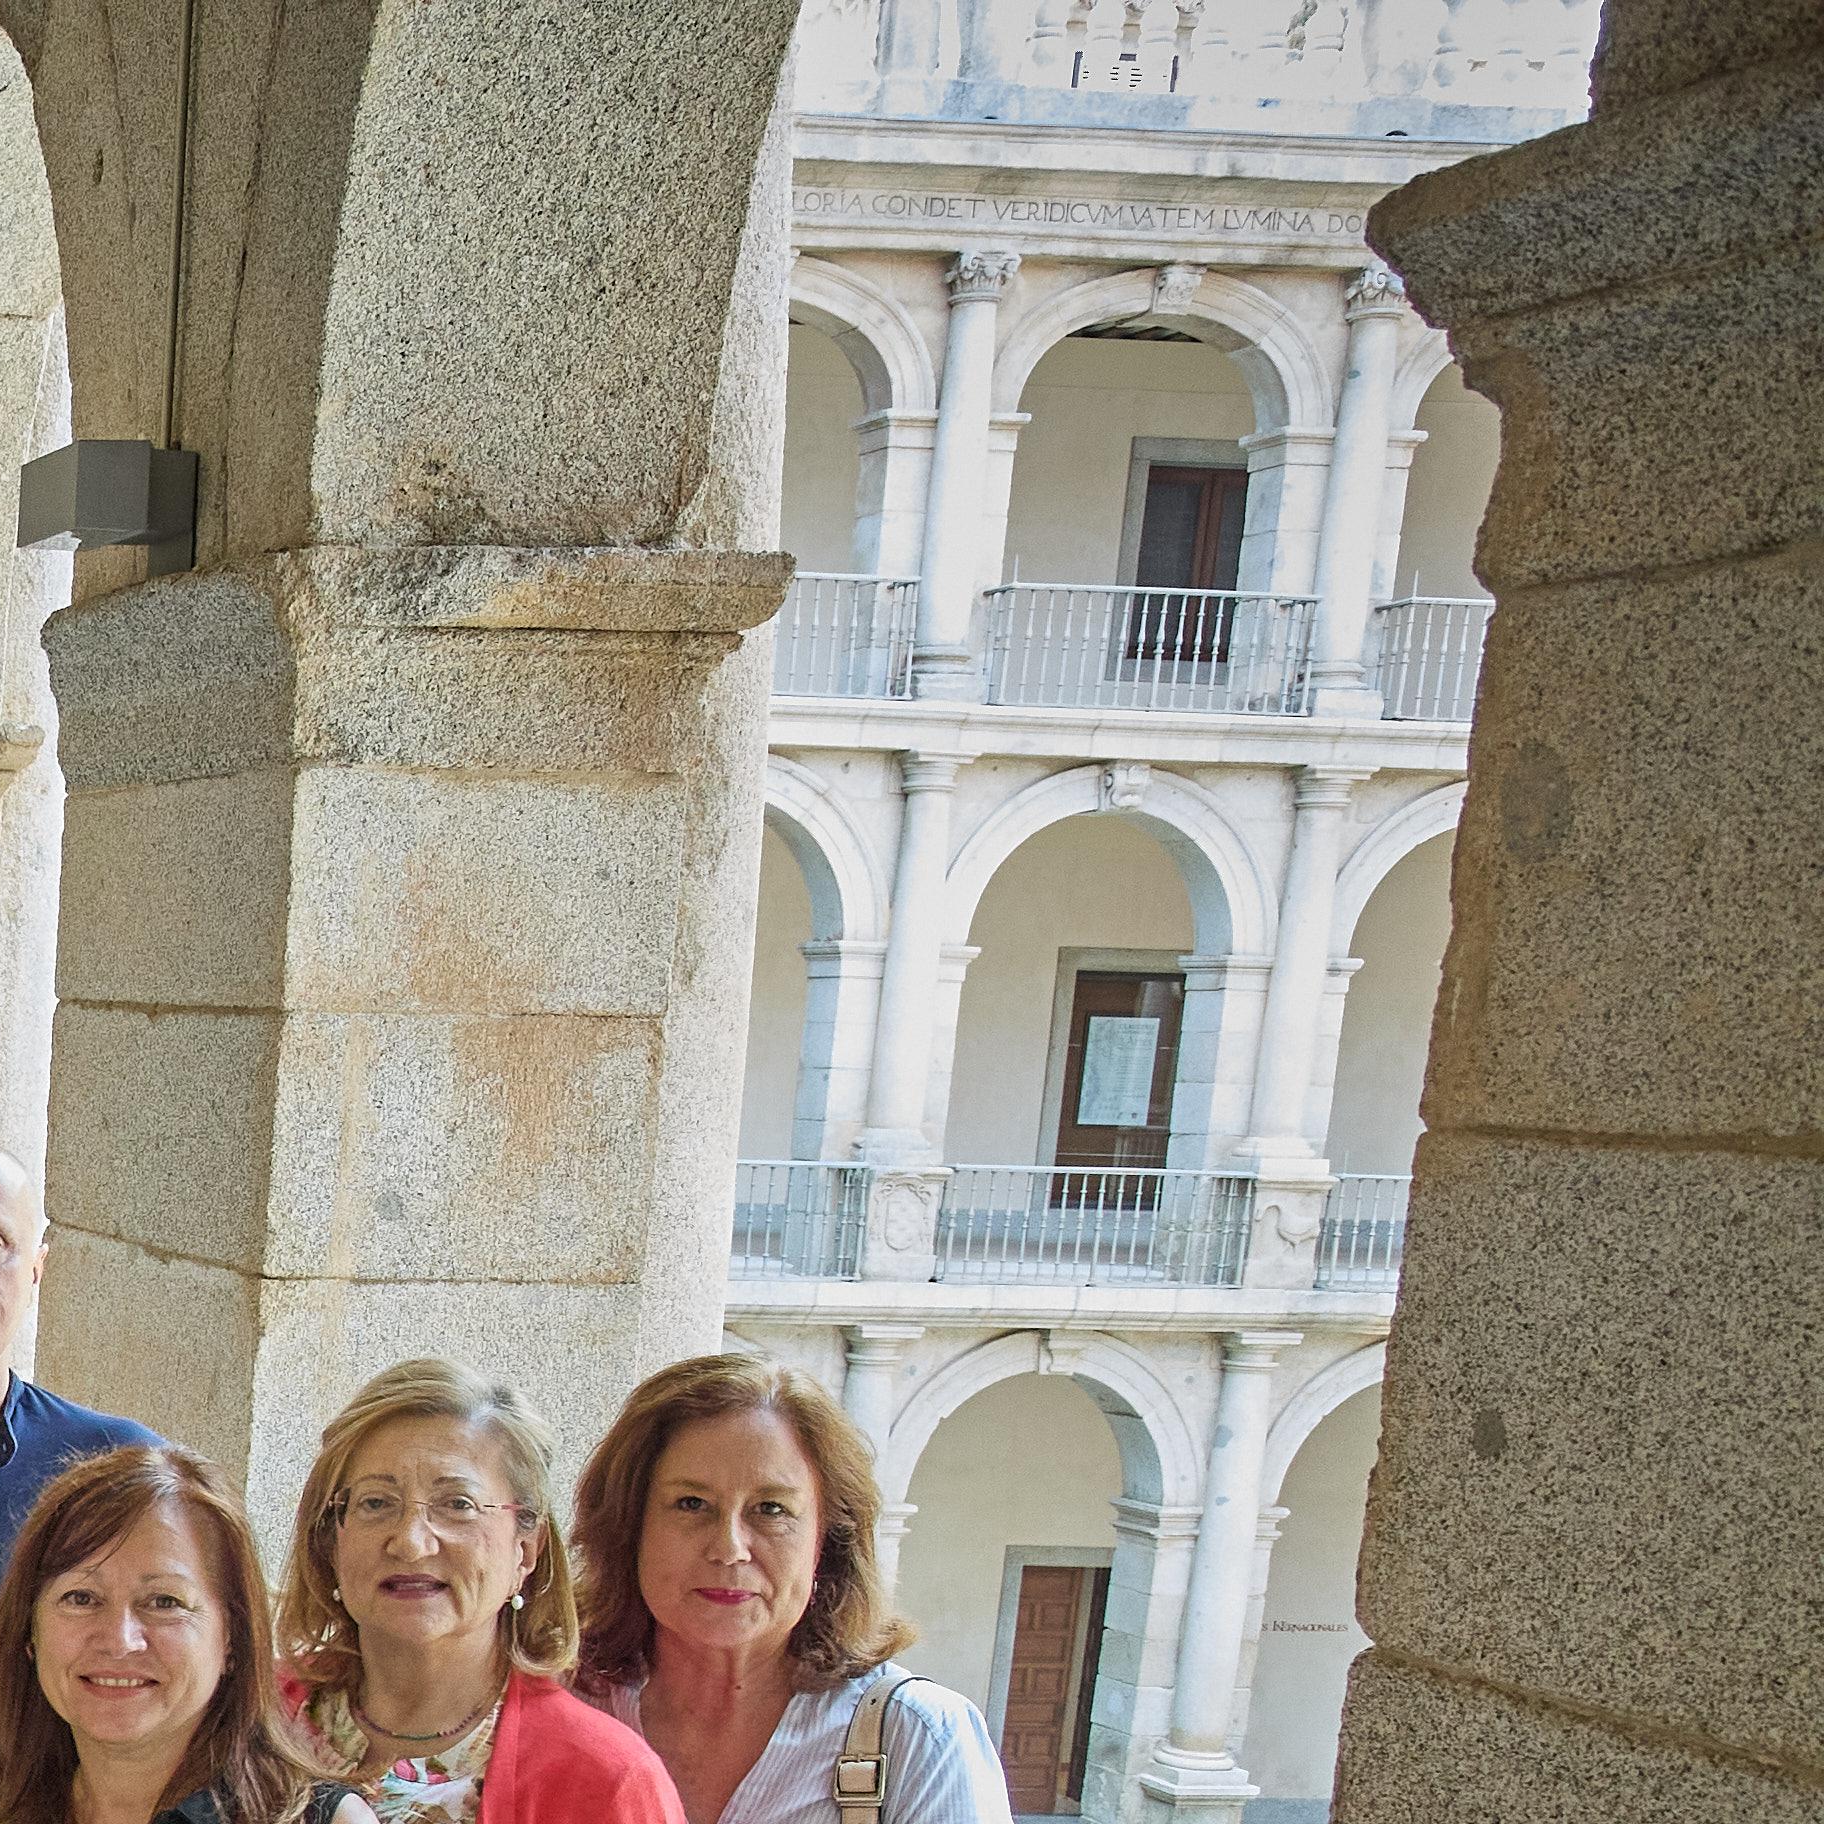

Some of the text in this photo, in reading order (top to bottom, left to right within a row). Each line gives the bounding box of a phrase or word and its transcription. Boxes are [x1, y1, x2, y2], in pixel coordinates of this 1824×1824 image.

[791, 190, 864, 214] LORIA
[871, 194, 986, 219] CONDET
[993, 199, 1123, 226] VERIDICVM
